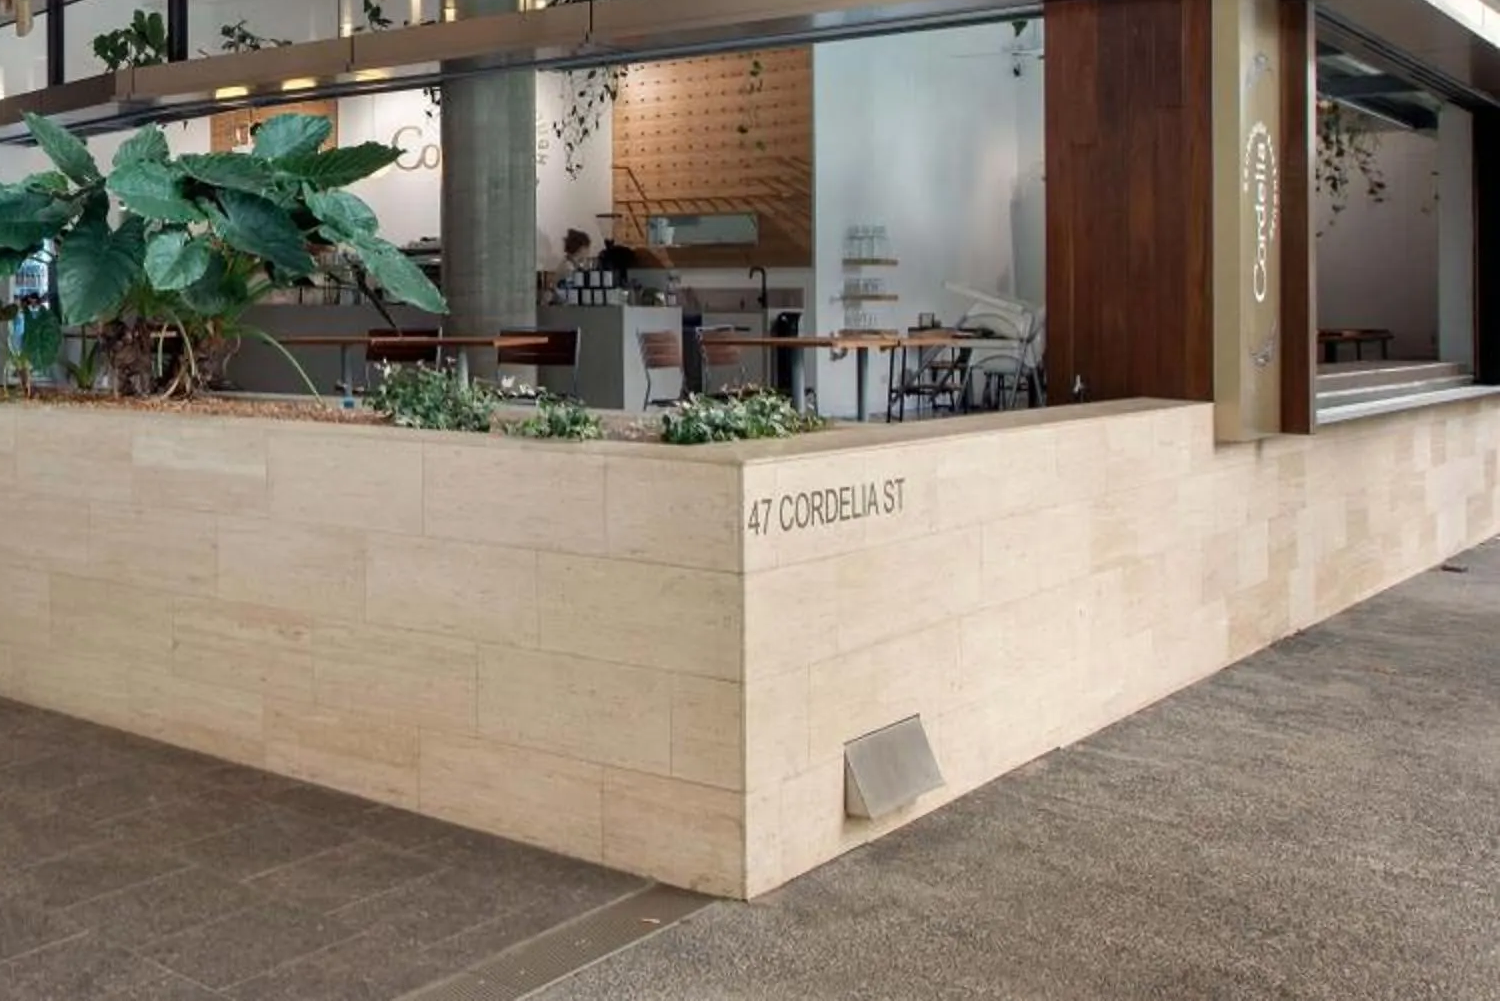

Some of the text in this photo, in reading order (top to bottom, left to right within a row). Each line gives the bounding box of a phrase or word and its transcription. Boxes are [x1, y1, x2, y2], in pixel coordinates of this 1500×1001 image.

[747, 477, 906, 536] 47 CORDELIA ST
